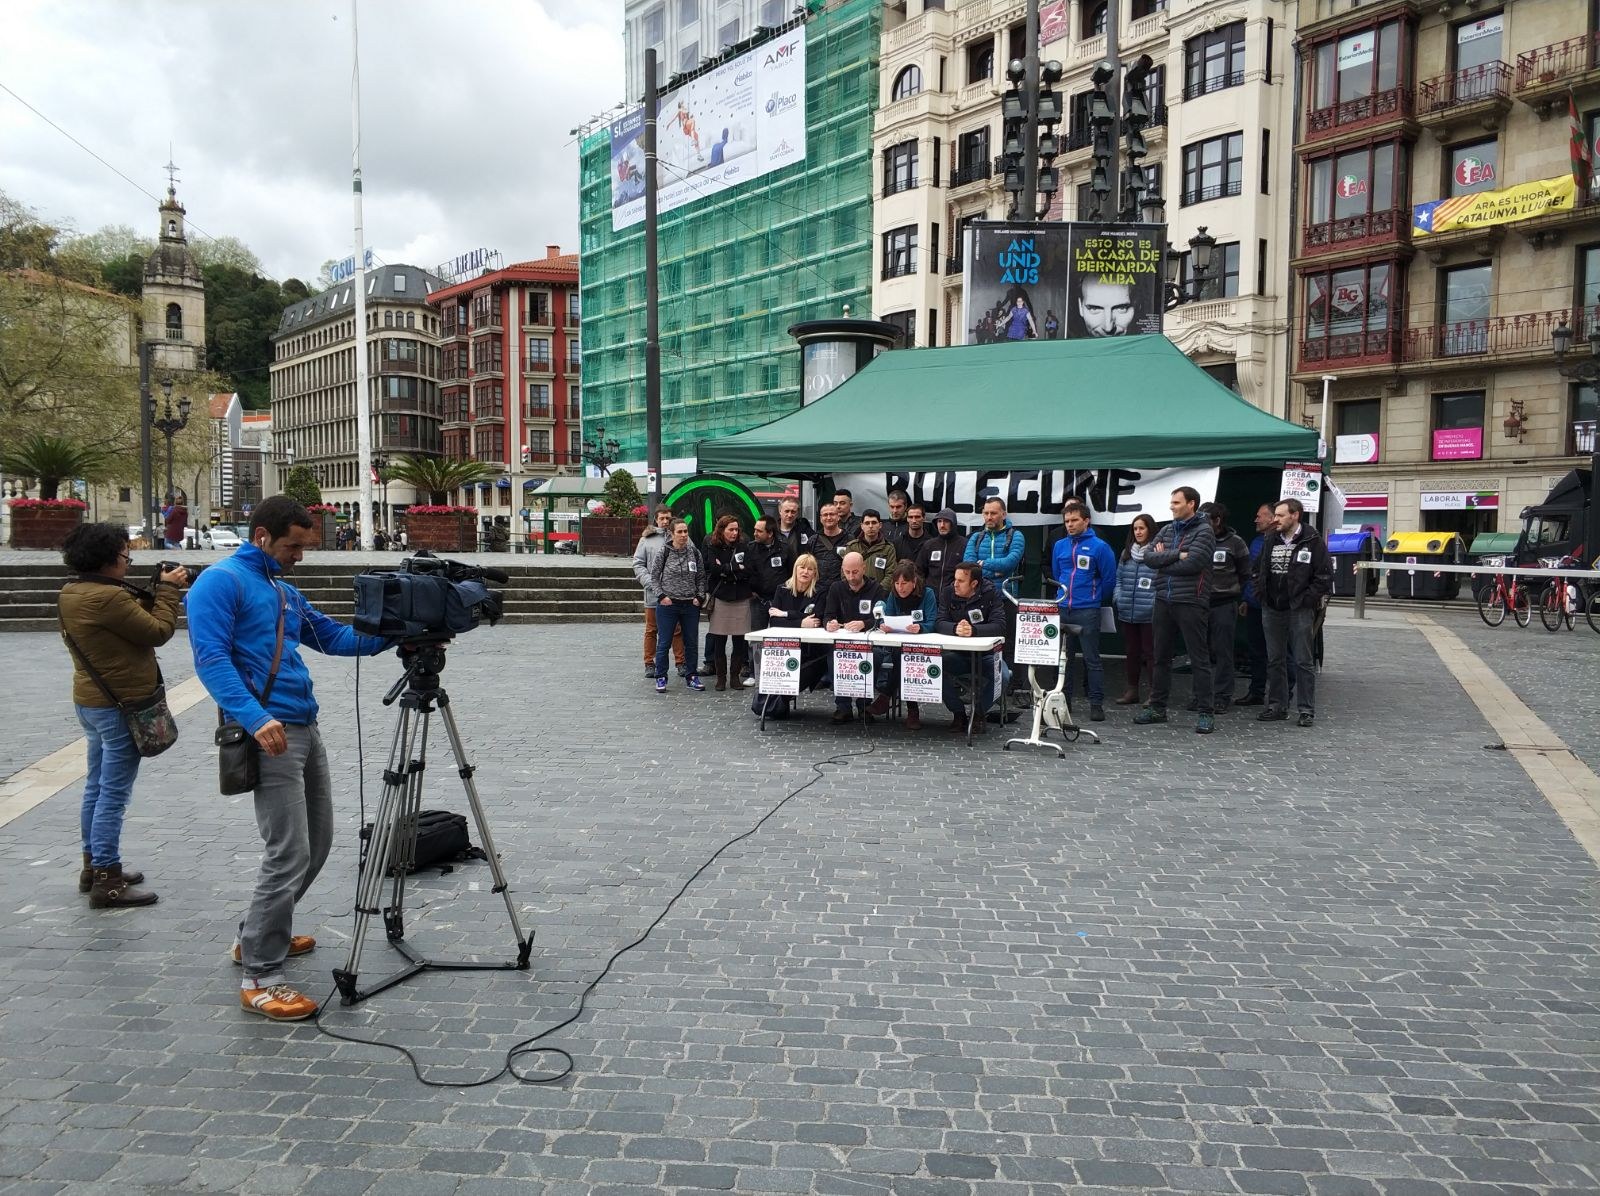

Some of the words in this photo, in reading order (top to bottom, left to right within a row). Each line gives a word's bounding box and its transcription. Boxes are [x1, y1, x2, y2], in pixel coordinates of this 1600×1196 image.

[763, 40, 799, 68] AMF
[778, 93, 797, 109] Placo
[1475, 200, 1496, 210] ARA
[1513, 189, 1551, 203] L'HORA
[1456, 206, 1517, 225] CATALUNYA
[1521, 195, 1565, 214] LLIURE!
[1007, 238, 1034, 252] AN
[1085, 239, 1112, 248] ESTO
[1117, 240, 1134, 249] NO
[1139, 239, 1152, 249] ES
[999, 252, 1041, 268] UND
[1075, 248, 1094, 260] LA
[1097, 249, 1136, 261] CASA
[1140, 250, 1160, 261] DE
[1076, 260, 1157, 274] BERNARDA
[1000, 268, 1039, 285] AUS
[1099, 273, 1136, 285] ALBA
[1019, 615, 1048, 623] GREBA
[904, 655, 931, 663] GREBA
[904, 677, 932, 685] HUELGA
